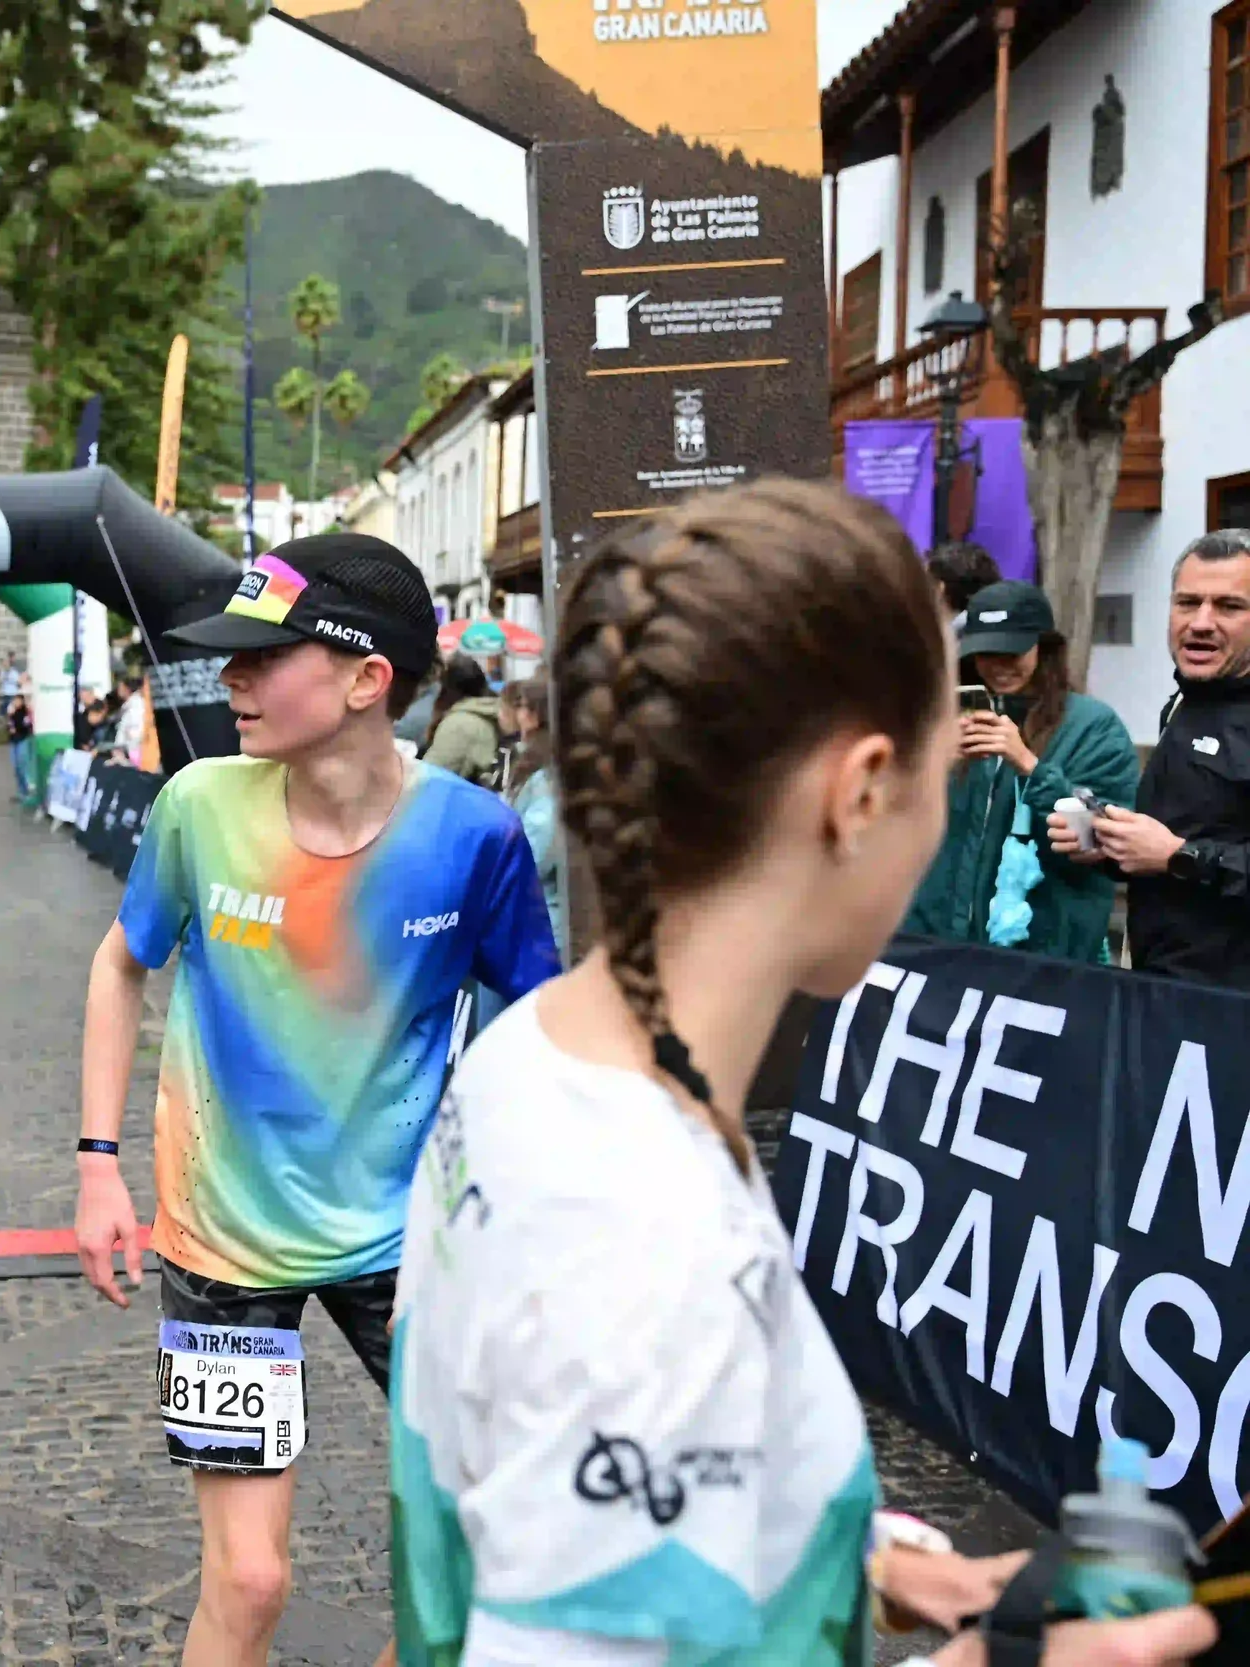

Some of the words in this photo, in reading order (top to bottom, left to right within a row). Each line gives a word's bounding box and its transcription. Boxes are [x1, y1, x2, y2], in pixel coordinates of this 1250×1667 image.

[593, 13, 660, 41] GRAN
[663, 7, 768, 38] CANARIA
[651, 194, 759, 215] Ayuntamiento
[651, 213, 671, 228] de
[676, 212, 701, 227] Las
[707, 209, 759, 224] Palmas
[671, 227, 706, 241] Gran
[707, 224, 759, 239] Canaria
[315, 619, 375, 650] FRACTEL
[207, 882, 286, 925] TRAIL
[209, 912, 273, 951] FAM
[403, 911, 459, 938] HOKA
[819, 961, 1067, 1180] THE
[200, 1330, 252, 1355] TRANS
[253, 1336, 274, 1346] GRAN
[253, 1346, 285, 1356] CANARIA
[196, 1360, 236, 1376] Dylan
[172, 1376, 265, 1419] 8126
